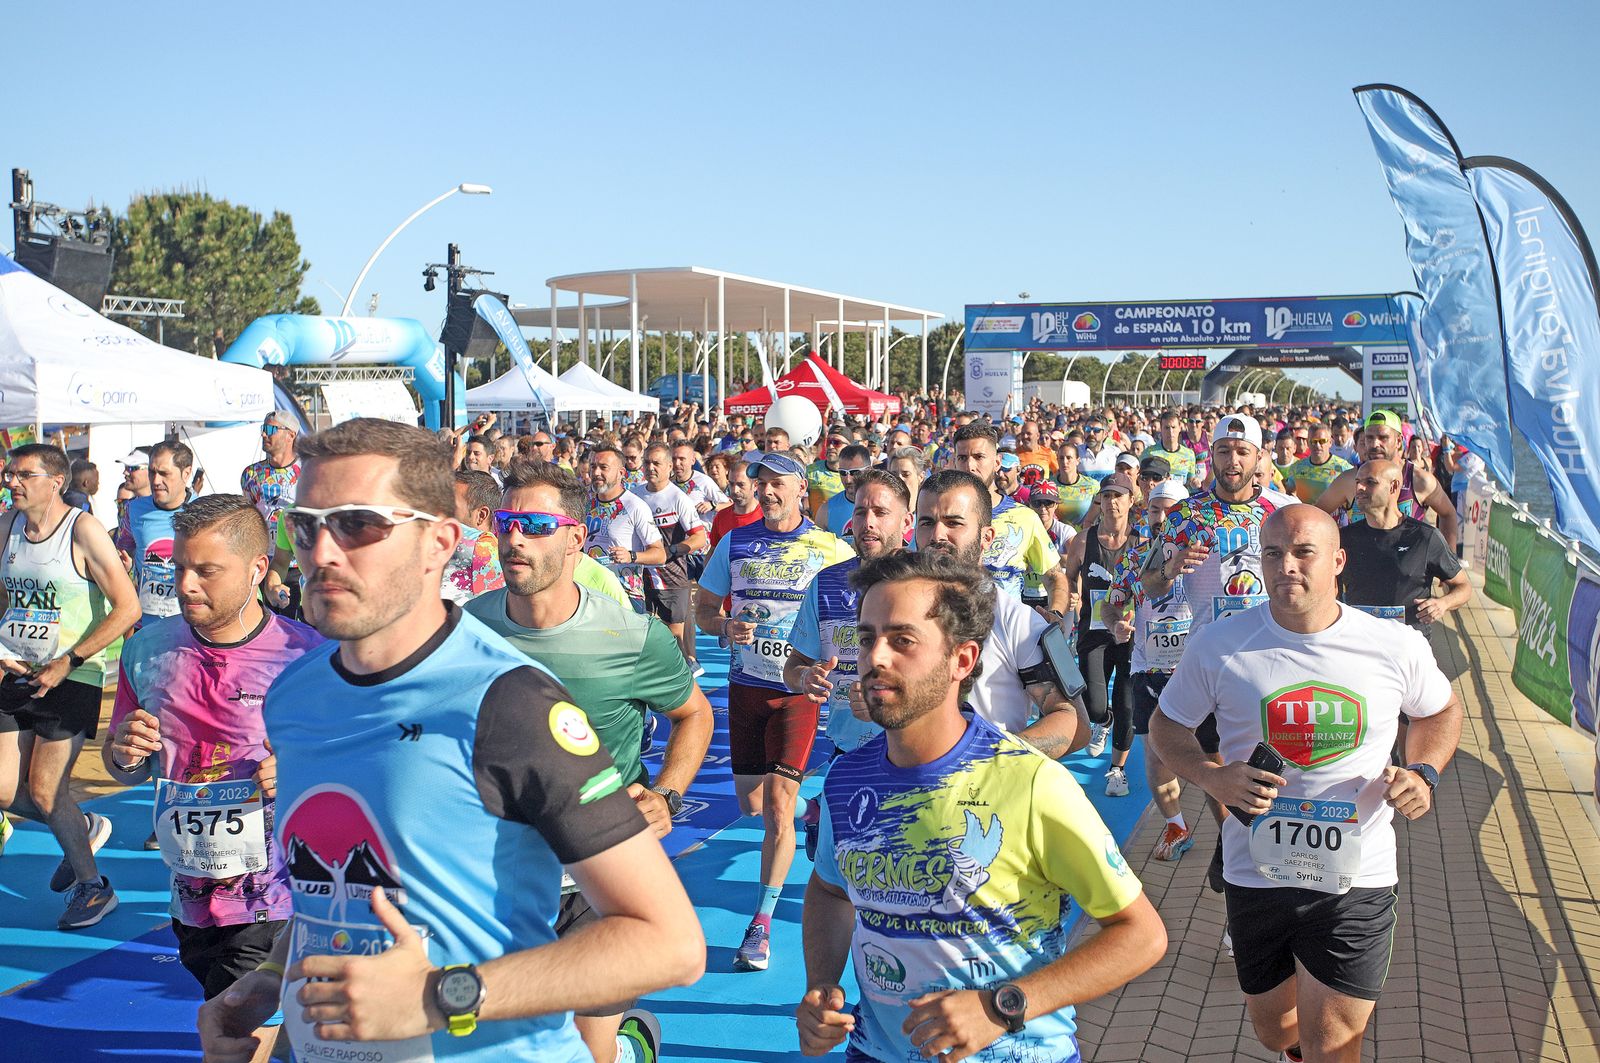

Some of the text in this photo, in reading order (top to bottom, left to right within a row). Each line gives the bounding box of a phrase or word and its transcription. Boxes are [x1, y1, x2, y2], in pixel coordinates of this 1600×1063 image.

[1115, 305, 1215, 320] CAMPEONATO
[1291, 312, 1333, 326] HUELVA
[1114, 317, 1251, 334] de ESPAÑA 10 km
[1162, 335, 1179, 343] ruta
[1180, 334, 1215, 343] Absoluto
[1223, 333, 1251, 342] Master
[1258, 355, 1279, 363] Huelva
[1305, 354, 1330, 362] sentidos
[149, 582, 178, 598] 167
[7, 589, 62, 610] TRAIL
[8, 622, 49, 640] 1722
[1153, 632, 1188, 648] 1307
[752, 639, 794, 658] 1686
[1276, 700, 1355, 726] TPL
[1271, 732, 1303, 741] JORGE
[218, 787, 250, 801] 2023
[1273, 802, 1350, 819] HUELVA 2023
[170, 808, 244, 836] 1575
[1269, 820, 1342, 851] 1700
[195, 841, 217, 849] FELIPE
[1290, 851, 1319, 861] CARLOS
[200, 861, 228, 872] Syrluz
[1296, 871, 1323, 883] Syrluz
[884, 891, 931, 907] ATLETISMO
[886, 915, 903, 930] DE
[905, 919, 921, 932] LA
[921, 917, 991, 936] FRONTERA
[304, 1042, 383, 1063] GALVEZ RAPOSO
